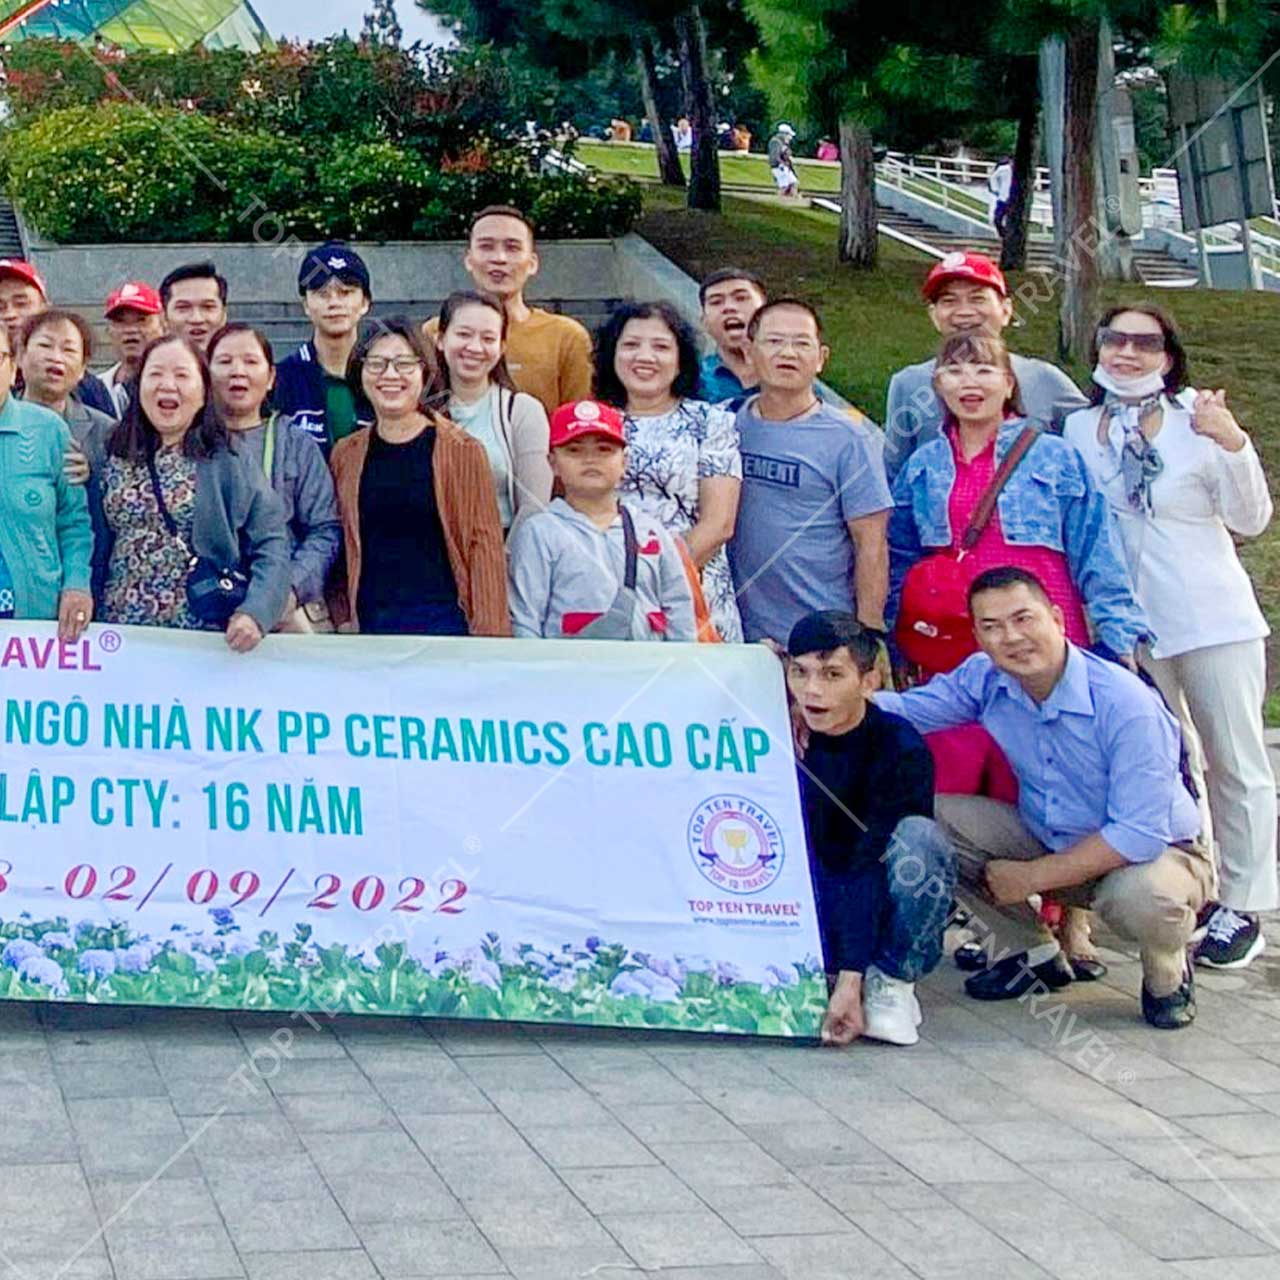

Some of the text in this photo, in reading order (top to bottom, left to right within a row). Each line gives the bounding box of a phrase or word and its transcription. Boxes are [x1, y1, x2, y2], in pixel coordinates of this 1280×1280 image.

[5, 695, 89, 747] NGÔ
[103, 697, 192, 751] NHÀ
[205, 706, 264, 753] NK
[277, 710, 331, 755] PP
[344, 713, 570, 766] CERAMICS
[583, 721, 673, 768] CAO
[685, 717, 771, 774] CẤP
[90, 776, 180, 829] CTY:
[202, 781, 251, 832] 16
[266, 777, 364, 837] NĂM
[688, 900, 714, 913] TOP
[716, 901, 743, 915] TEN
